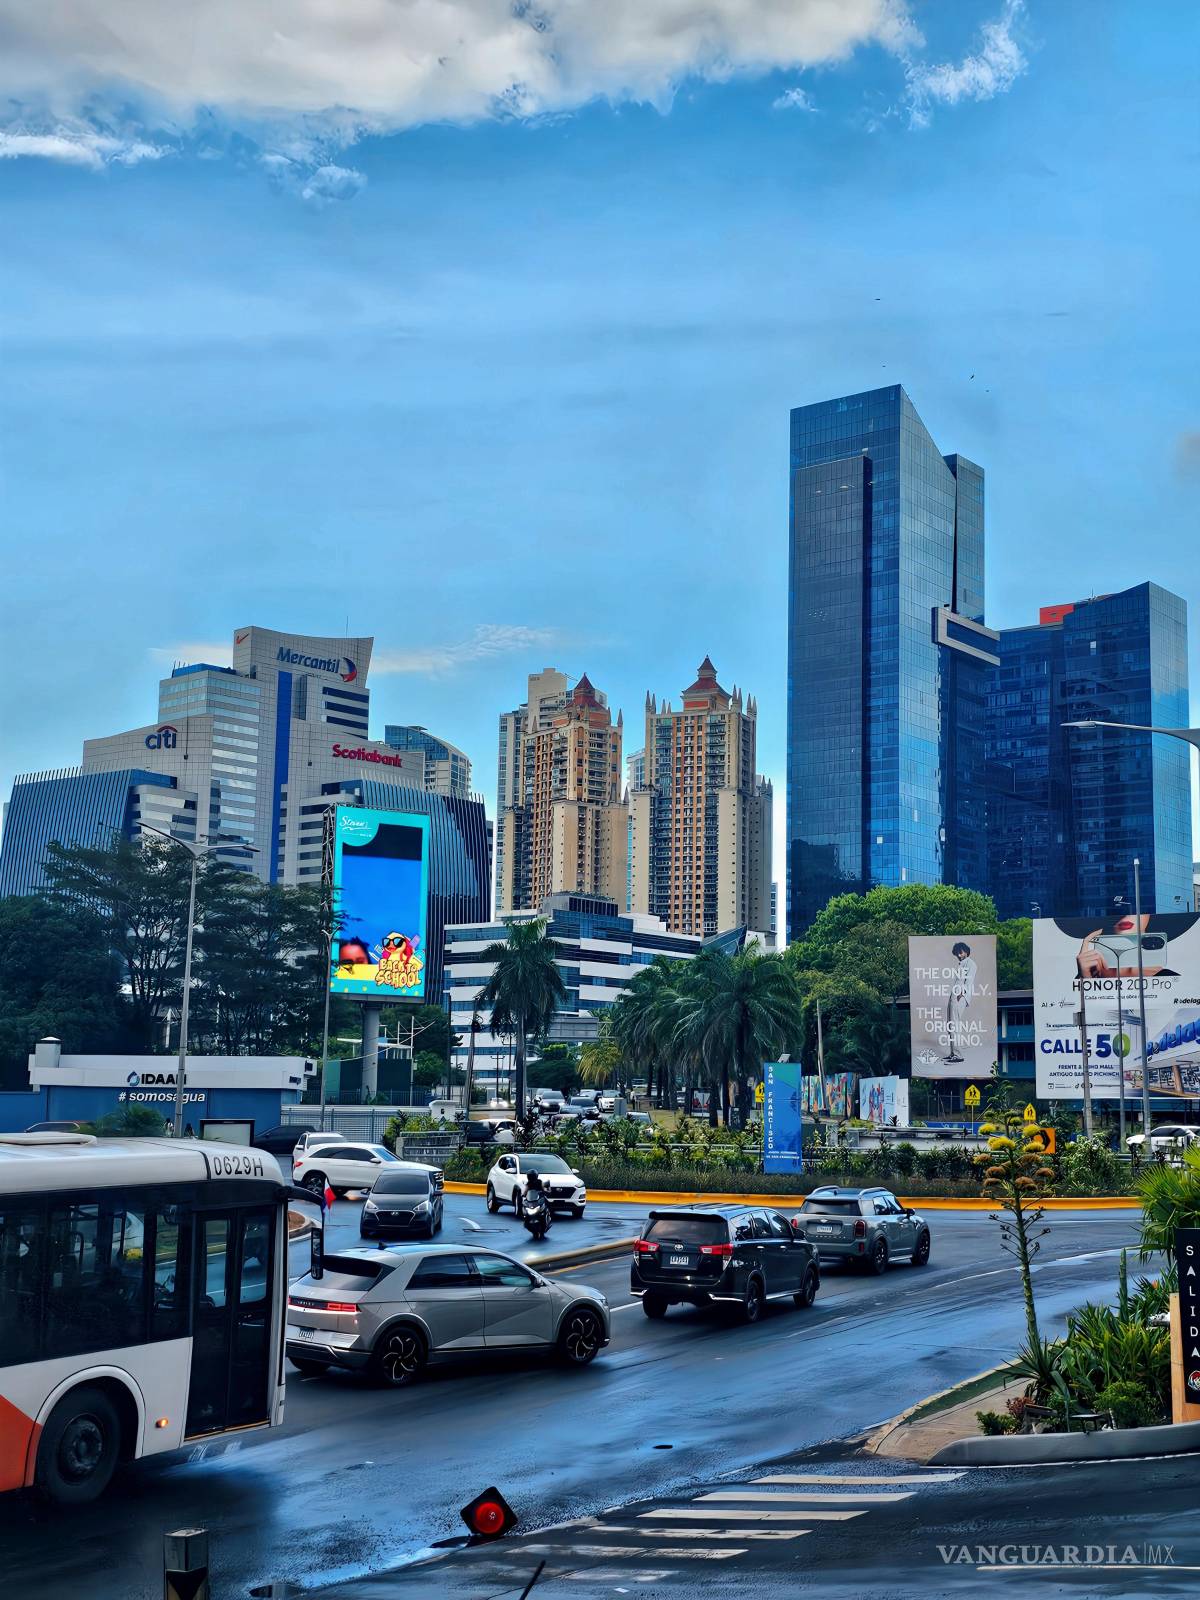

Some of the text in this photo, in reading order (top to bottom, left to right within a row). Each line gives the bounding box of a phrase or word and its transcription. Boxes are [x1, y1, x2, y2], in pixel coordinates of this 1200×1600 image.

[277, 647, 339, 674] Mercantil
[145, 728, 177, 750] citi
[332, 743, 403, 768] Scotiabank
[379, 957, 418, 974] BACK TO
[914, 967, 970, 980] THE ONE
[375, 970, 422, 989] SCHOOL
[1072, 979, 1123, 992] HONOR
[1127, 978, 1148, 991] 200
[1152, 978, 1172, 990] Pro
[924, 983, 992, 996] THE ONLY.
[916, 1007, 942, 1019] THE
[924, 1020, 988, 1033] ORIGINAL
[938, 1034, 983, 1047] CHINO.
[1040, 1033, 1131, 1058] CALLE 50
[213, 1155, 264, 1177] 0629H
[1185, 1244, 1200, 1358] SALIDA
